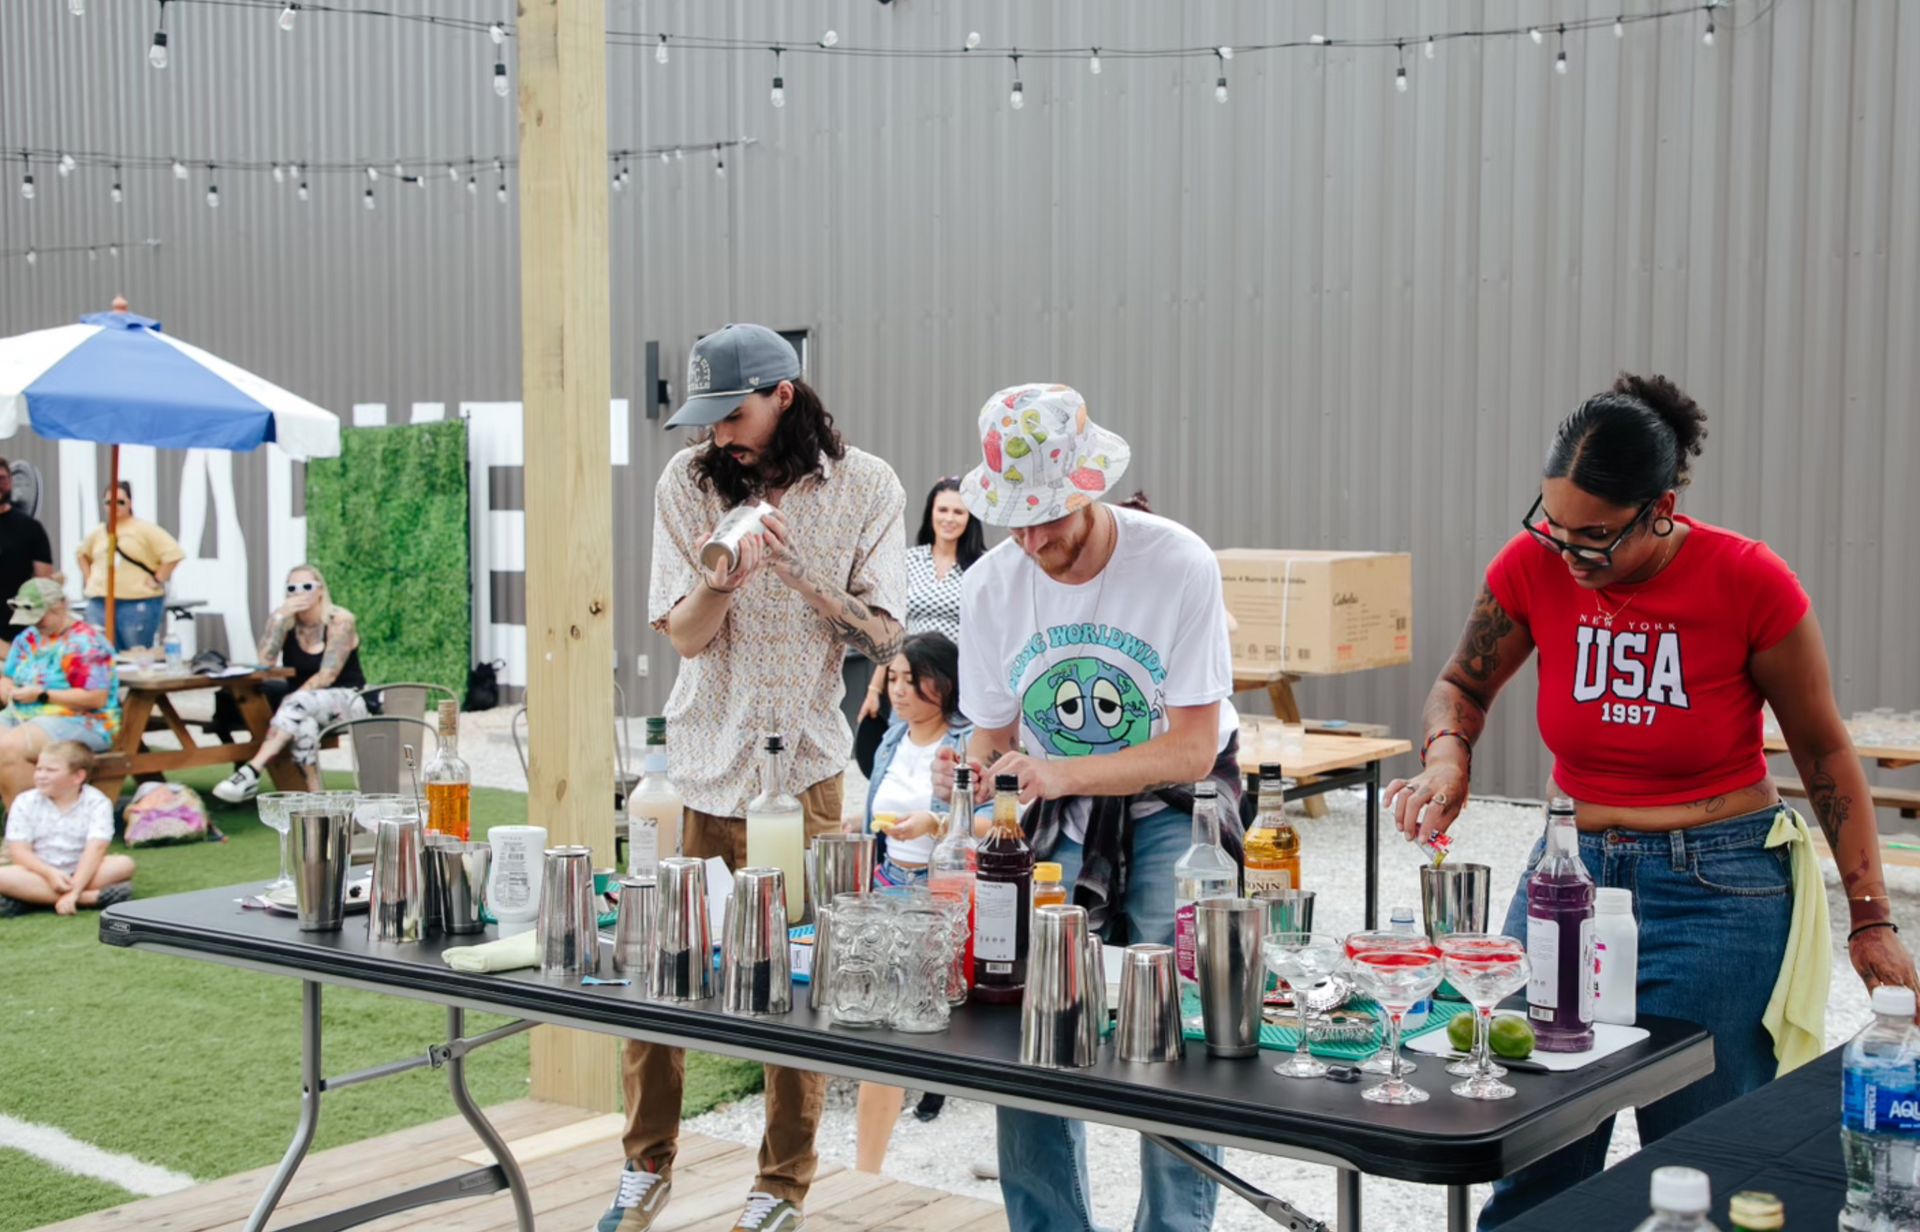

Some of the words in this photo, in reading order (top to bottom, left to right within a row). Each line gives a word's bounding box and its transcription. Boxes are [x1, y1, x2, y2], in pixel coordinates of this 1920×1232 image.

[1580, 614, 1613, 627] NEW
[1628, 621, 1676, 630] YORK
[1047, 623, 1168, 685] WORLDWIDE
[1572, 624, 1690, 710] USA
[1601, 701, 1657, 725] 1997
[1245, 882, 1280, 890] ONIN
